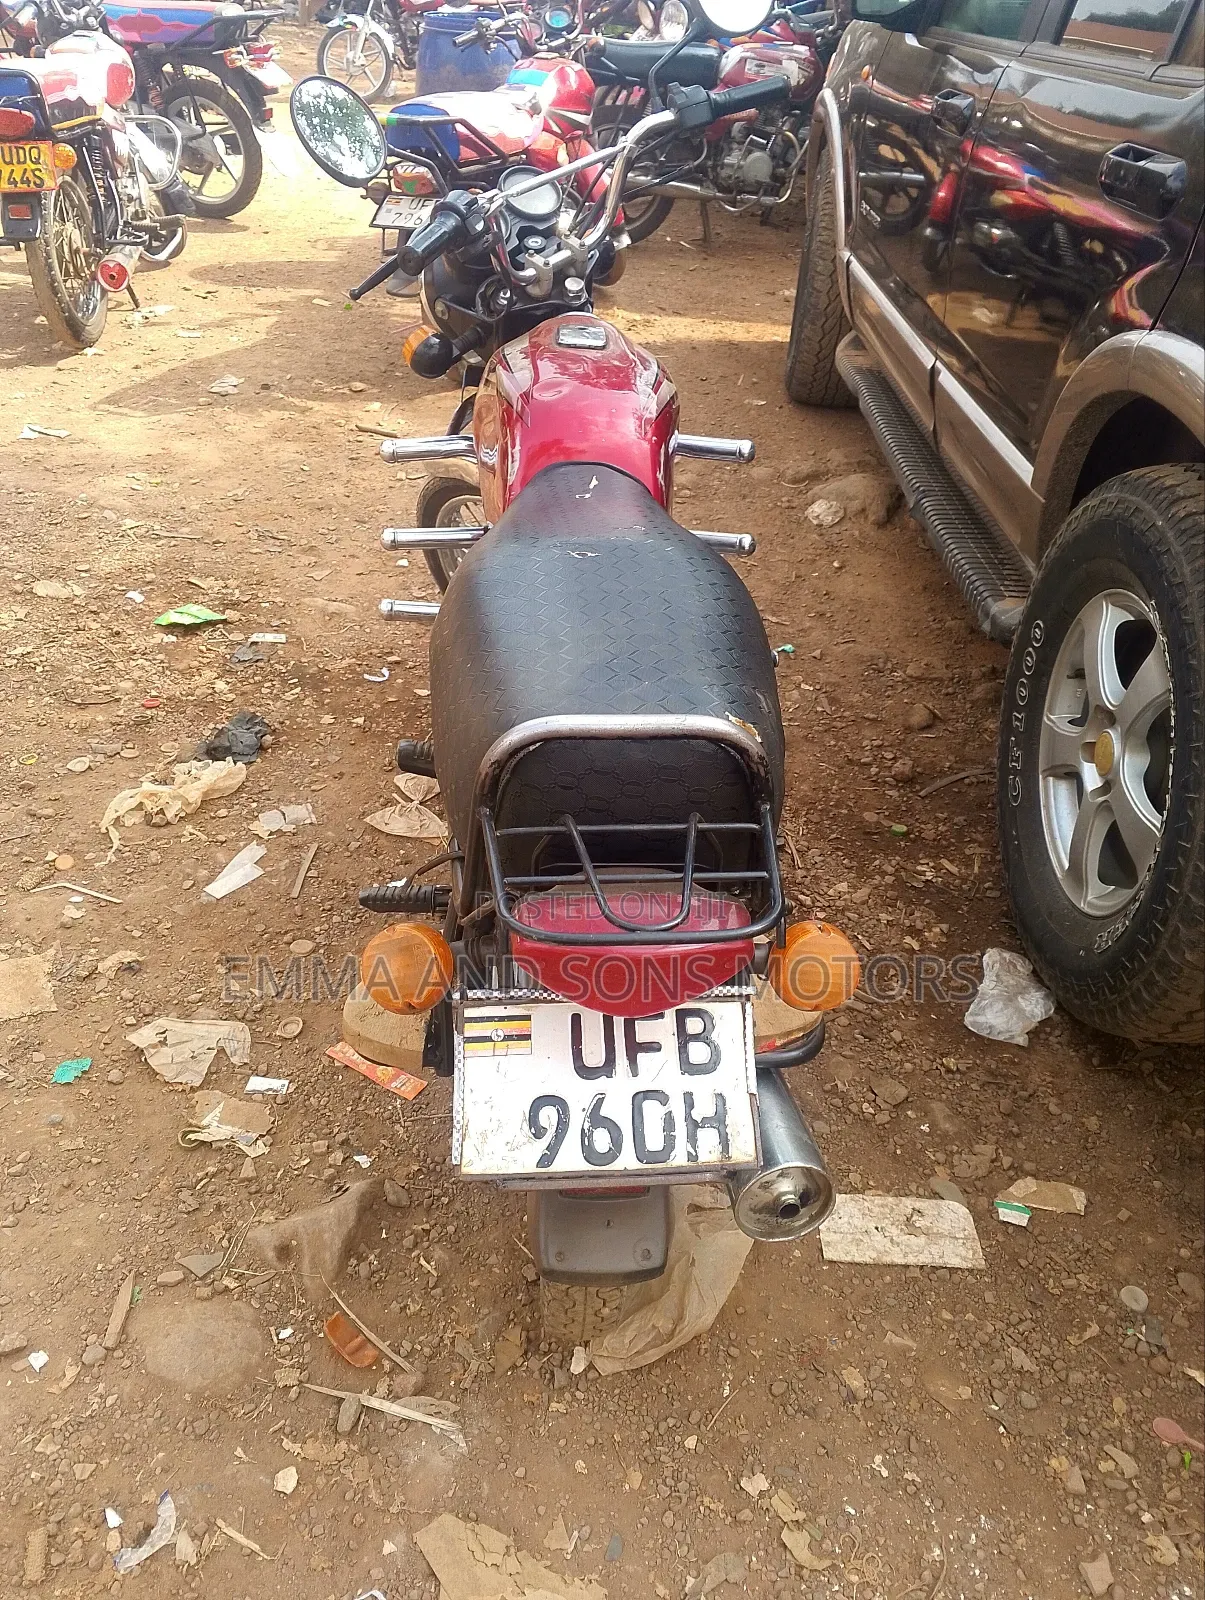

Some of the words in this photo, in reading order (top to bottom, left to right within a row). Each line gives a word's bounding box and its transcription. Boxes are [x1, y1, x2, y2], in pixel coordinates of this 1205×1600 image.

[1, 146, 42, 165] UDQ
[408, 198, 441, 210] UF
[391, 212, 423, 226] 796
[570, 1007, 722, 1081] UFB
